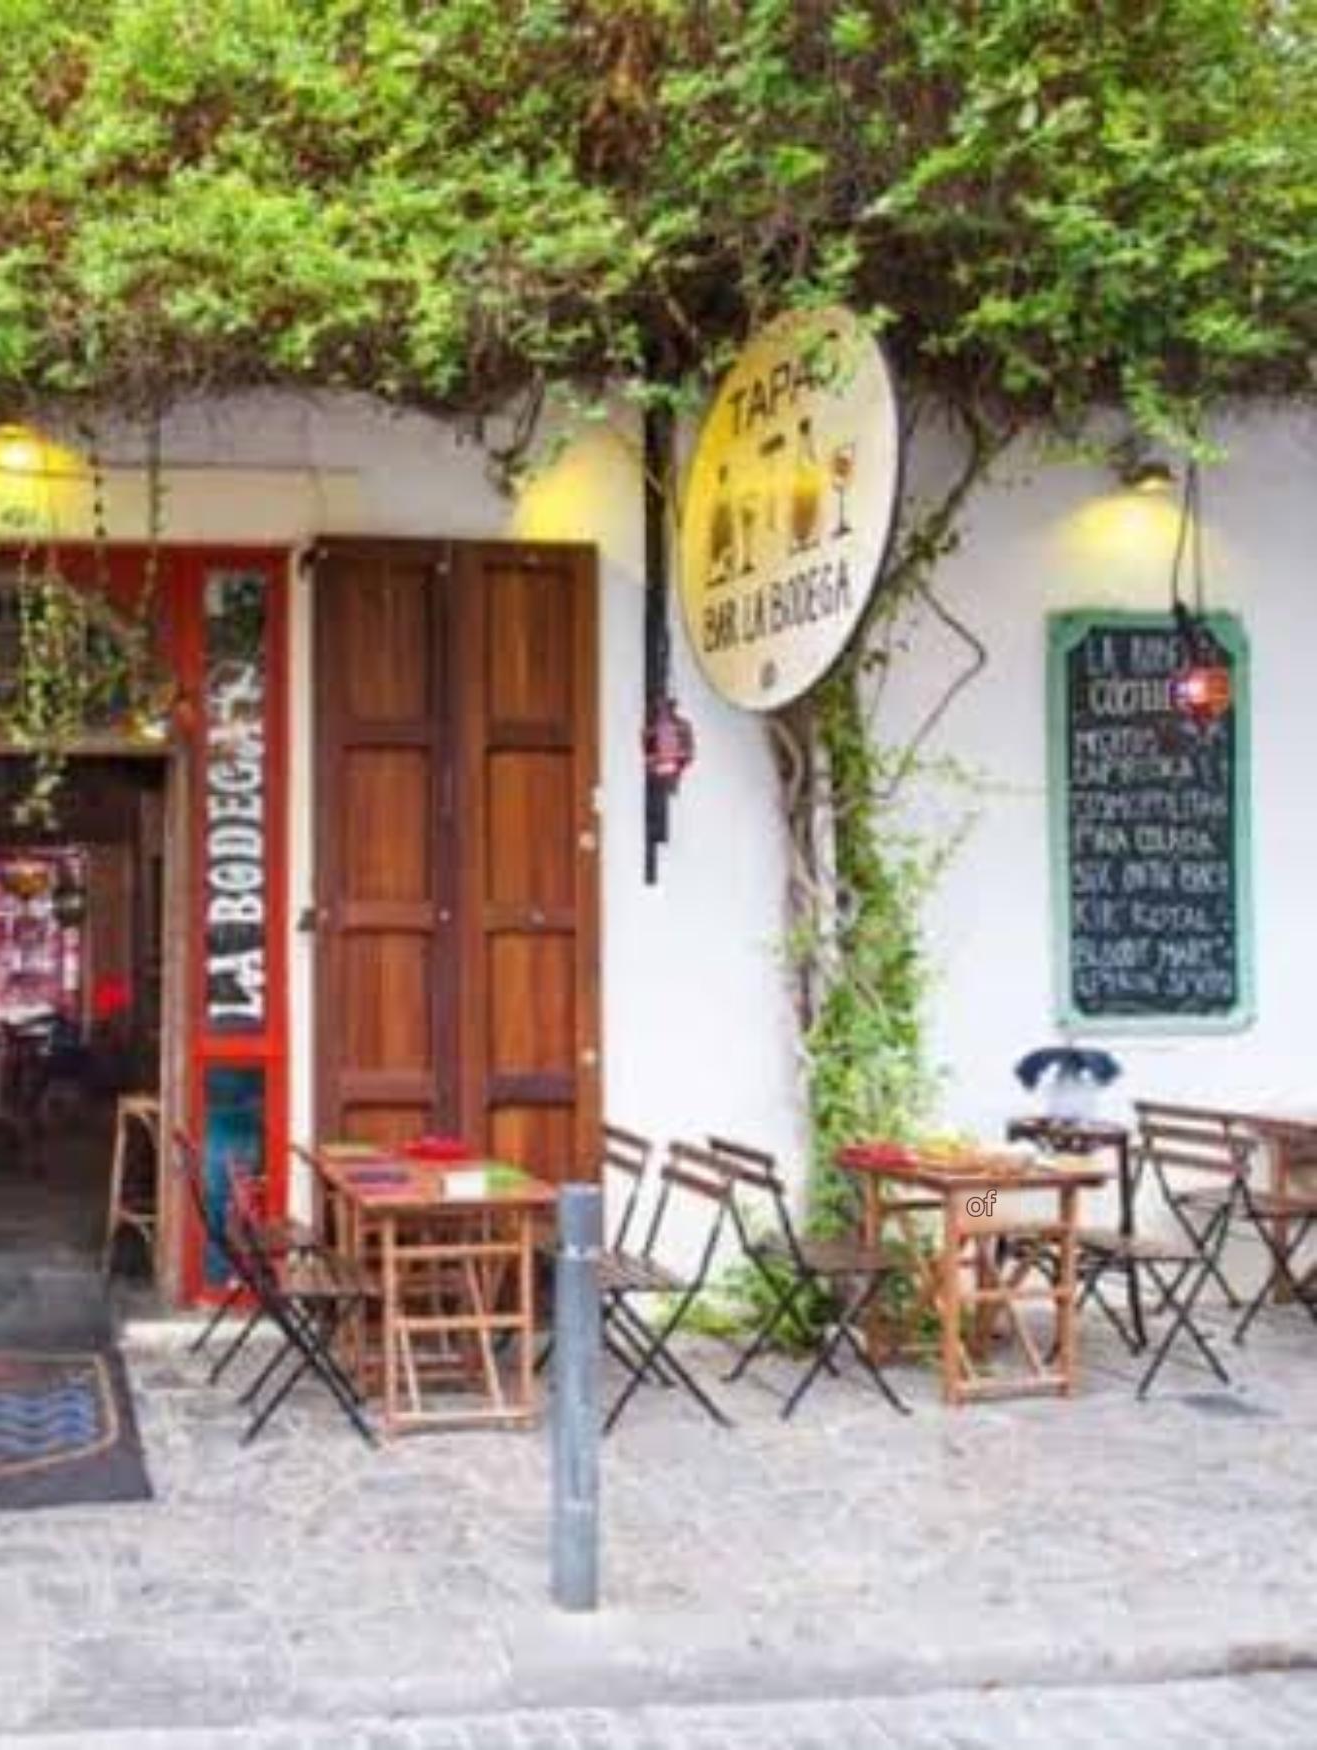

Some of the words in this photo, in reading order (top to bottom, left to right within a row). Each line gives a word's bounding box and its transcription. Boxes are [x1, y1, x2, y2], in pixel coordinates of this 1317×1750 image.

[703, 597, 739, 652] BAR
[743, 588, 765, 643] LA
[770, 558, 853, 633] BODEGA
[208, 950, 265, 1018] LA
